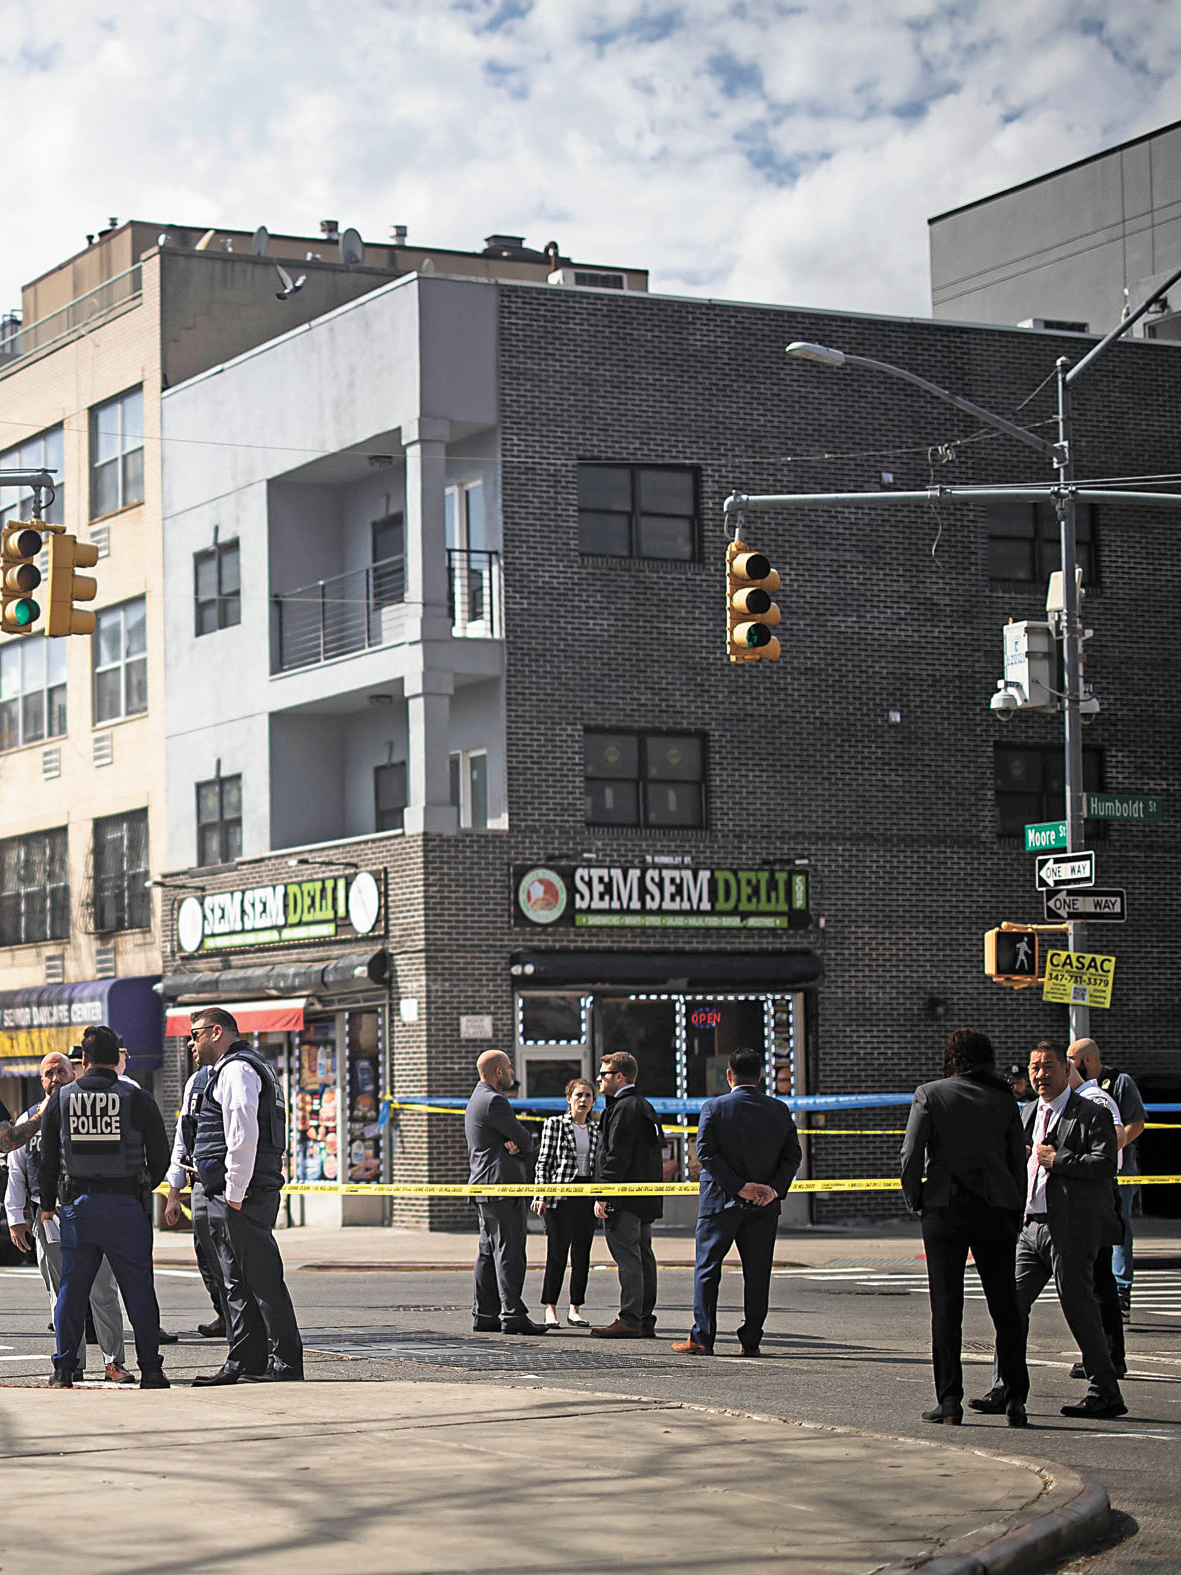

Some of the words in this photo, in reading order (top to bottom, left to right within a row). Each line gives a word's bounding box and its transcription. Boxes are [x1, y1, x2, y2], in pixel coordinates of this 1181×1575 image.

[1090, 797, 1144, 818] Humboldt
[1148, 801, 1157, 812] St
[1028, 829, 1056, 848] Moore
[1059, 825, 1066, 837] St
[1045, 866, 1062, 879] ONE
[1069, 864, 1087, 876] WAY
[575, 867, 641, 910] SEM
[645, 868, 712, 911] SEM
[714, 870, 788, 911] DELI
[204, 891, 244, 935] SEM
[243, 884, 286, 930] SEM
[286, 879, 336, 925] DELI
[1054, 899, 1079, 911] ONE
[1092, 899, 1118, 911] WAY
[1049, 952, 1112, 974] CASAC
[1048, 972, 1109, 988] 347-731-3379
[32, 1004, 69, 1025] DAYCARE
[71, 1001, 102, 1022] CENTER
[692, 1012, 721, 1024] OPEN
[70, 1092, 120, 1116] NYPD
[70, 1116, 121, 1134] POLICE
